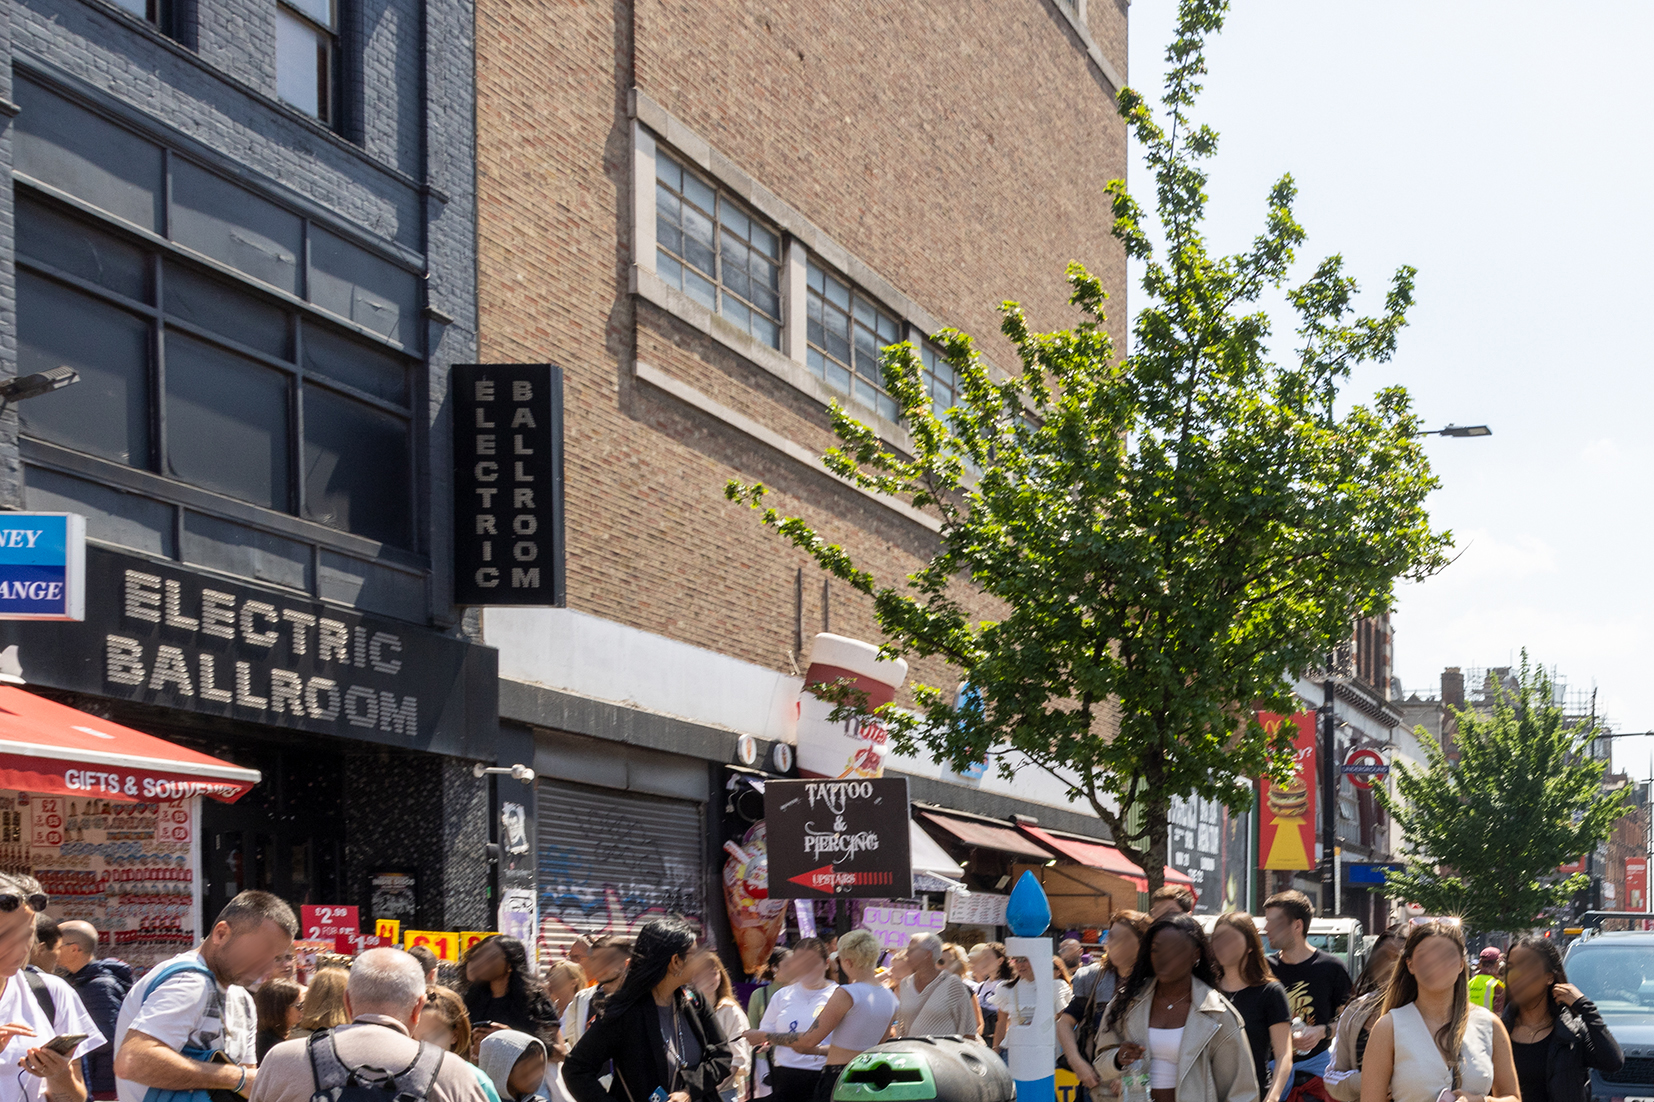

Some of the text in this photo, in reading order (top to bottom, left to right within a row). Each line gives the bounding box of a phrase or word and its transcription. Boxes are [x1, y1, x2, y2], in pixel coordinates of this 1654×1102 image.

[474, 380, 499, 588] ELECTRIC
[511, 380, 540, 589] BALLROOM
[124, 569, 402, 675] ELECTRIC
[106, 634, 418, 737] BALLROOM
[65, 769, 120, 794] GIFTS
[124, 776, 138, 796] &
[805, 782, 873, 814] TATTOO
[833, 815, 847, 832] &
[804, 822, 879, 864] PIERCING
[315, 907, 347, 924] £2.99
[864, 908, 945, 928] BUBBLE
[309, 926, 321, 942] 2
[348, 933, 380, 950] £1.99
